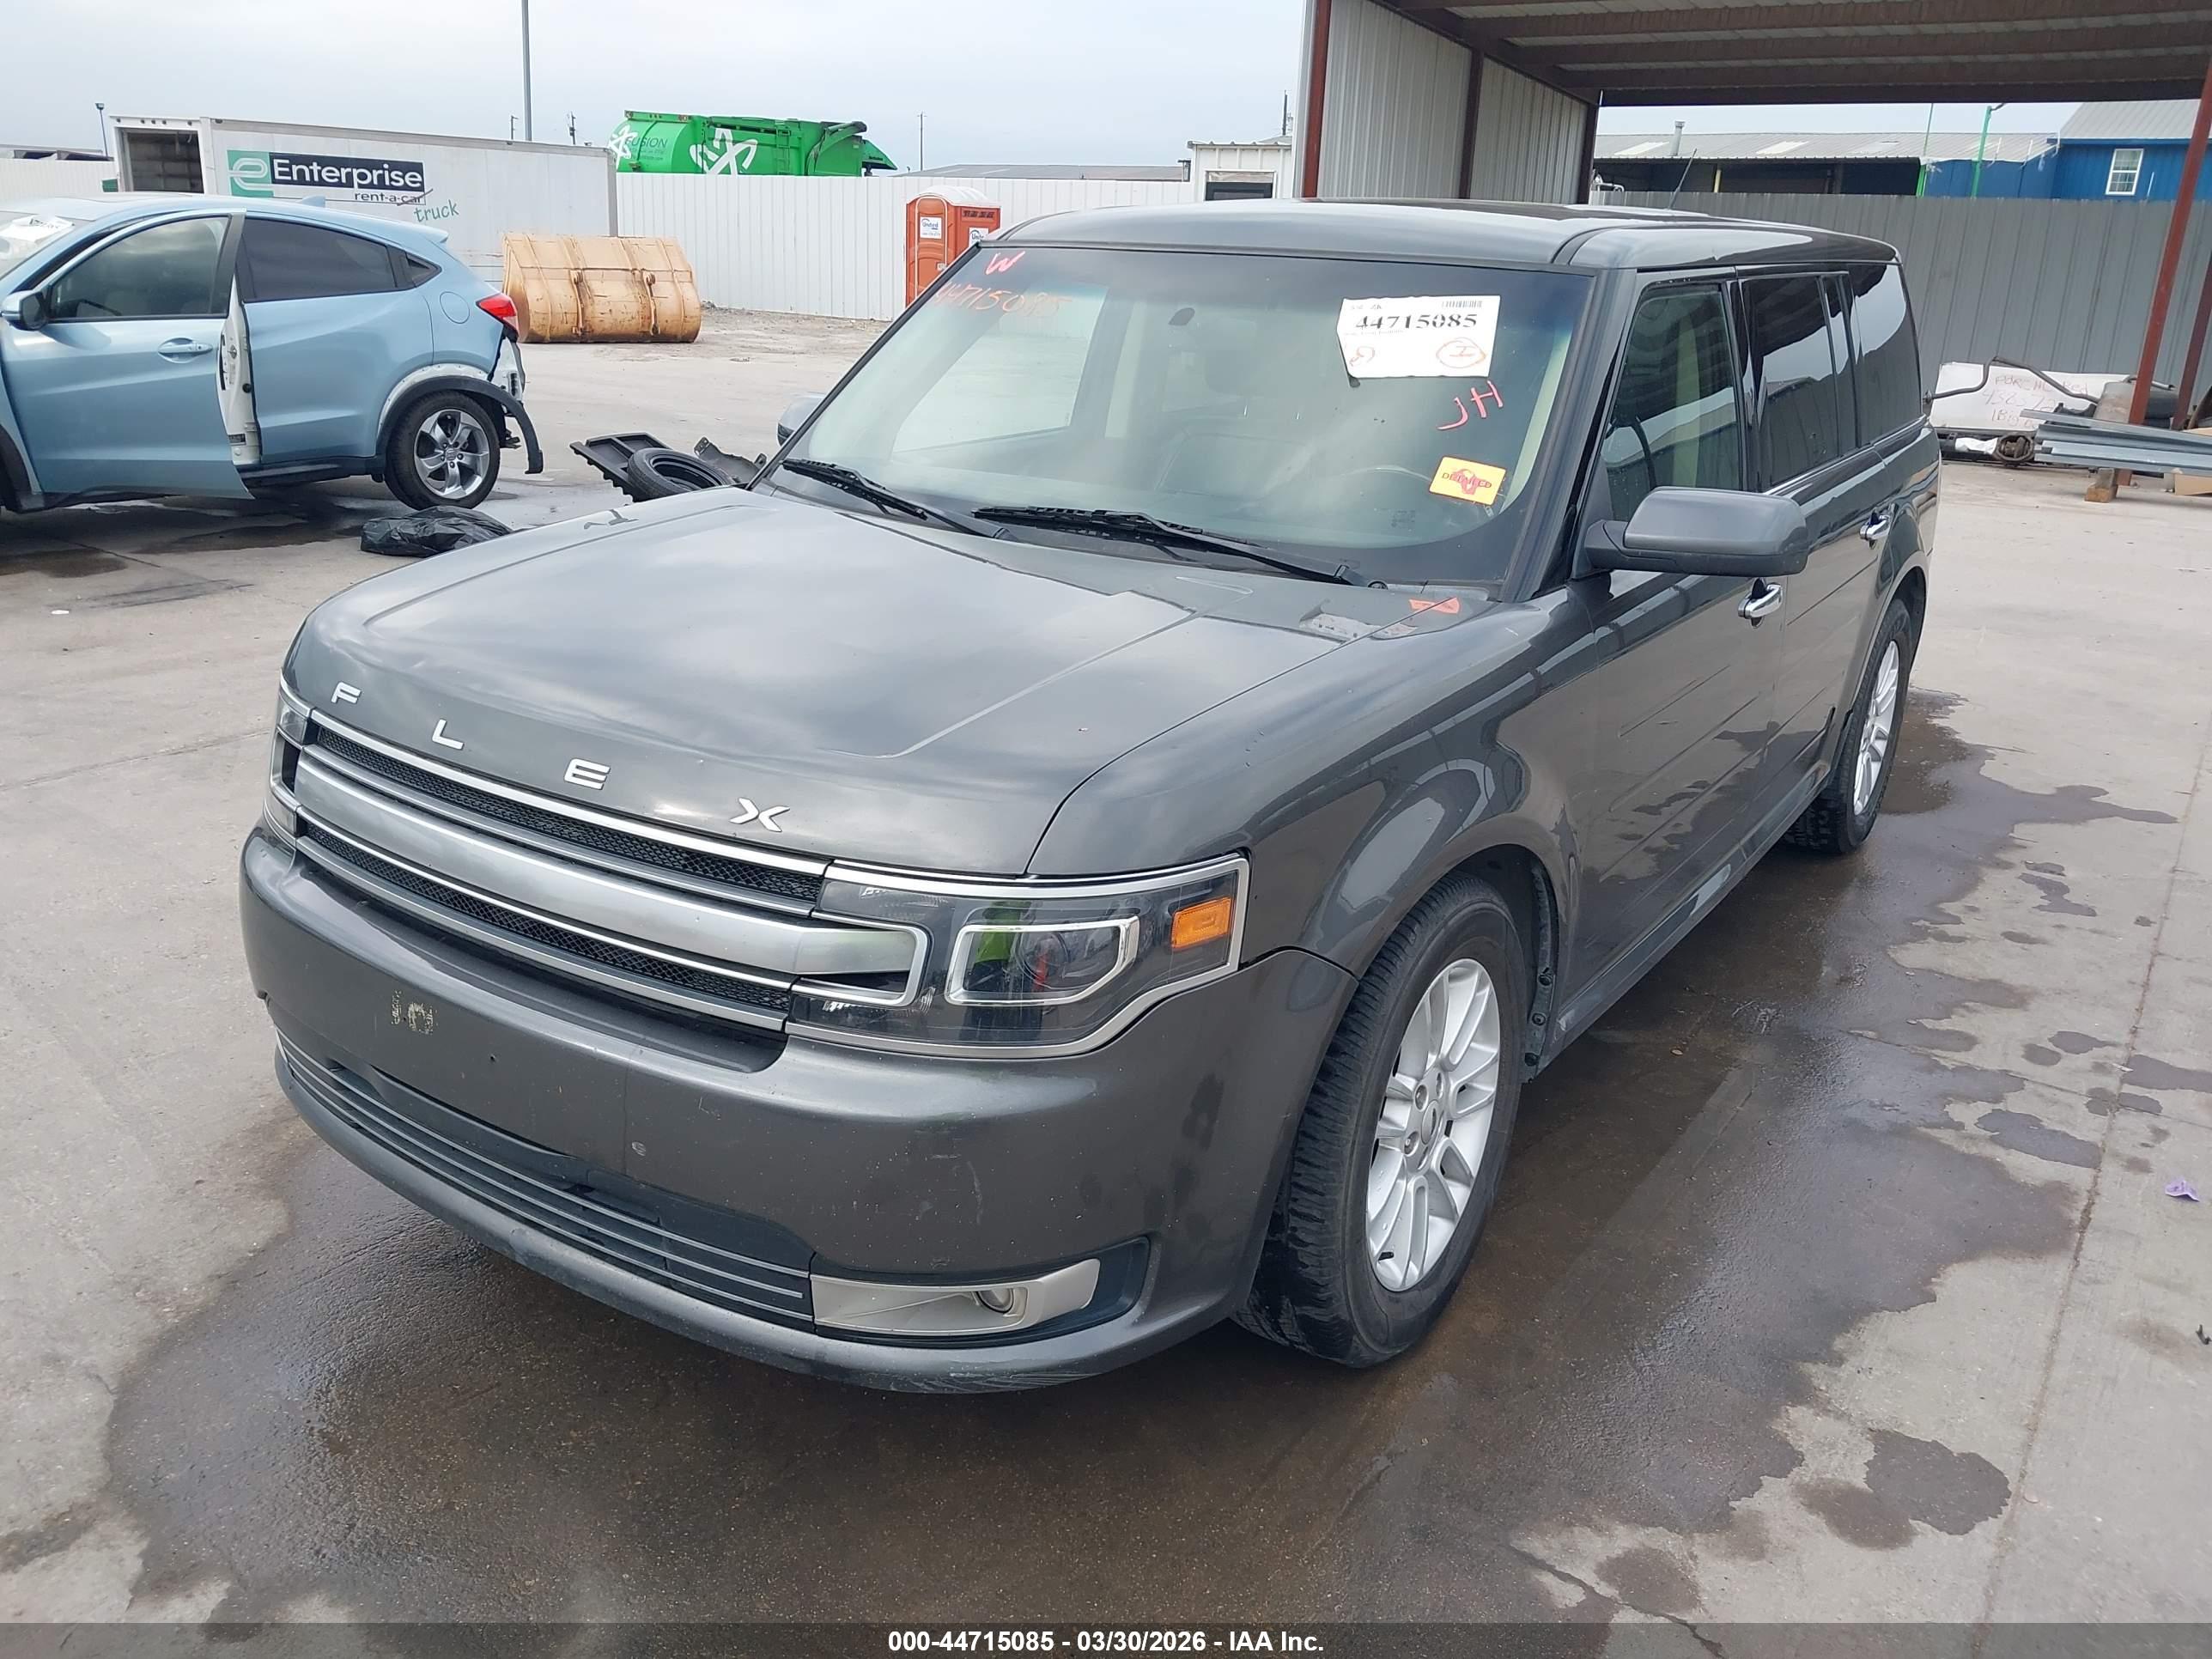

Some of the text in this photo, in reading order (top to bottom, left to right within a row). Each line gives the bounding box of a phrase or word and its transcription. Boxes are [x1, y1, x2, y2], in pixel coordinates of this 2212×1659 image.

[272, 158, 422, 189] Enterprise
[354, 191, 423, 204] rent-a-car
[413, 199, 460, 222] truck
[985, 251, 1025, 276] W
[1355, 313, 1478, 330] 44715085
[331, 681, 791, 833] FLEX
